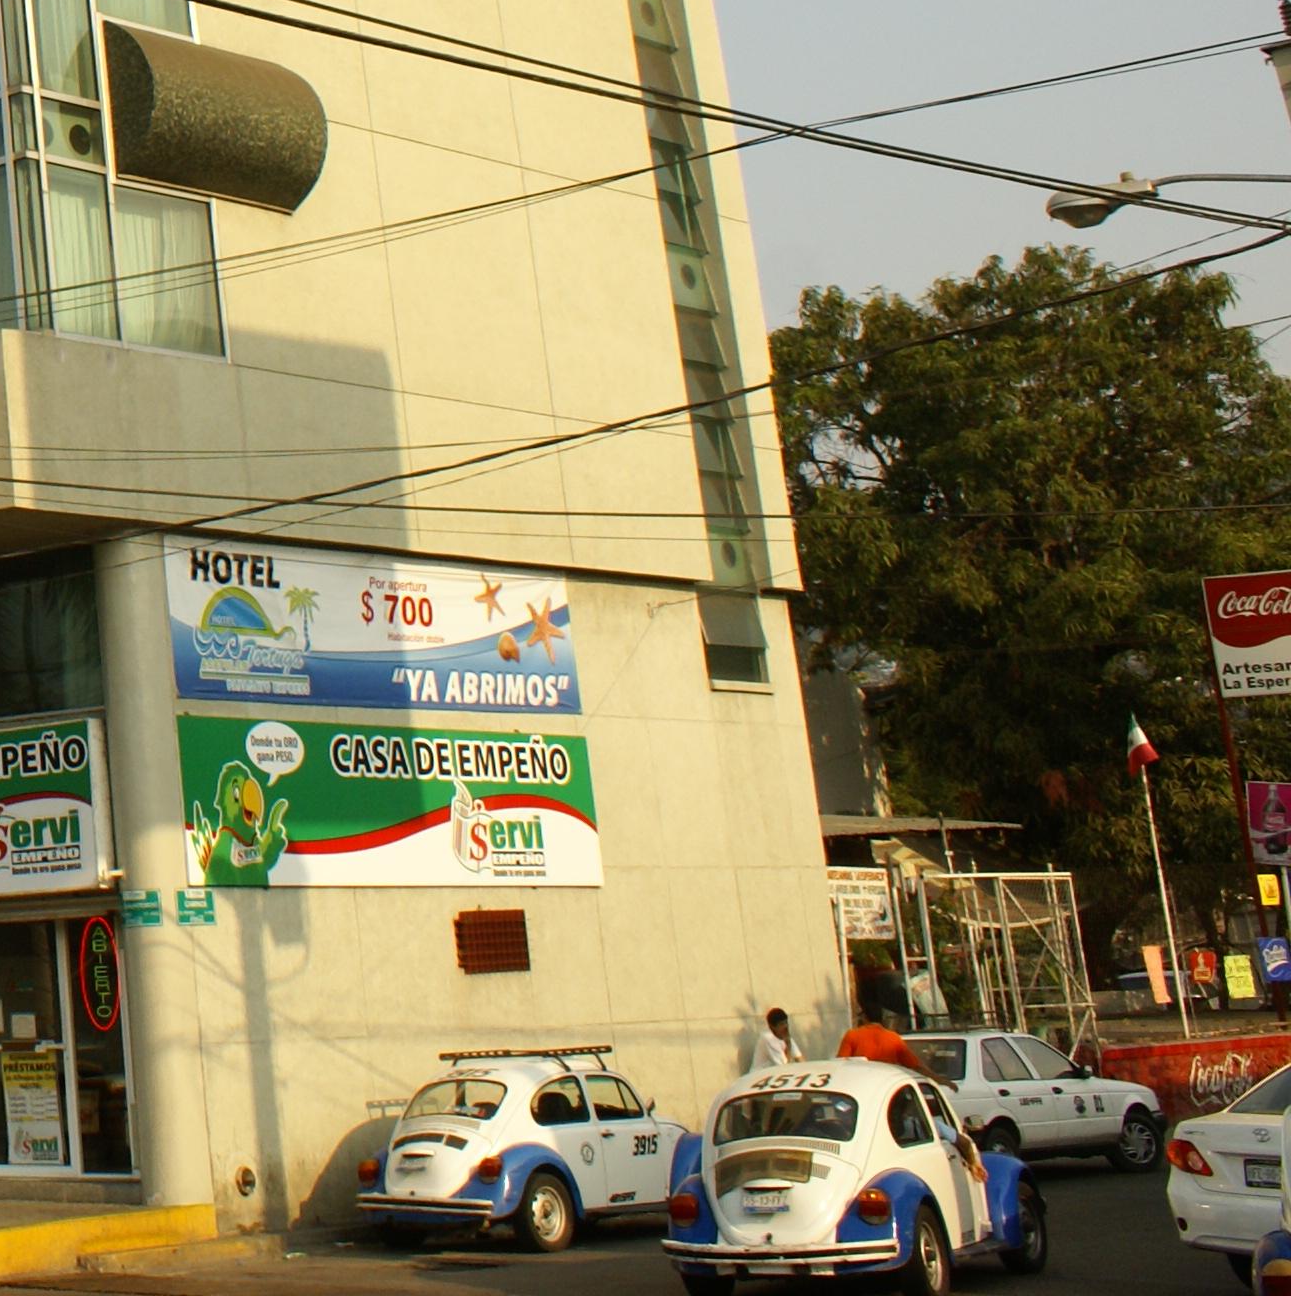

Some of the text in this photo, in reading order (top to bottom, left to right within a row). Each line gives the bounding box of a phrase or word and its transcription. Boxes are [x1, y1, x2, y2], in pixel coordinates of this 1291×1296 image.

[189, 547, 281, 589] HOTEL
[369, 576, 428, 593] Por apertura
[361, 590, 434, 628] $ 700
[1222, 678, 1241, 690] La
[331, 735, 571, 782] CASA DE EMPEÑO
[12, 846, 81, 864] EMPEÑO
[492, 851, 545, 867] EMPEÑO
[92, 925, 113, 1018] ABIERTO
[750, 1072, 832, 1090] 4513
[632, 1134, 659, 1156] 3915
